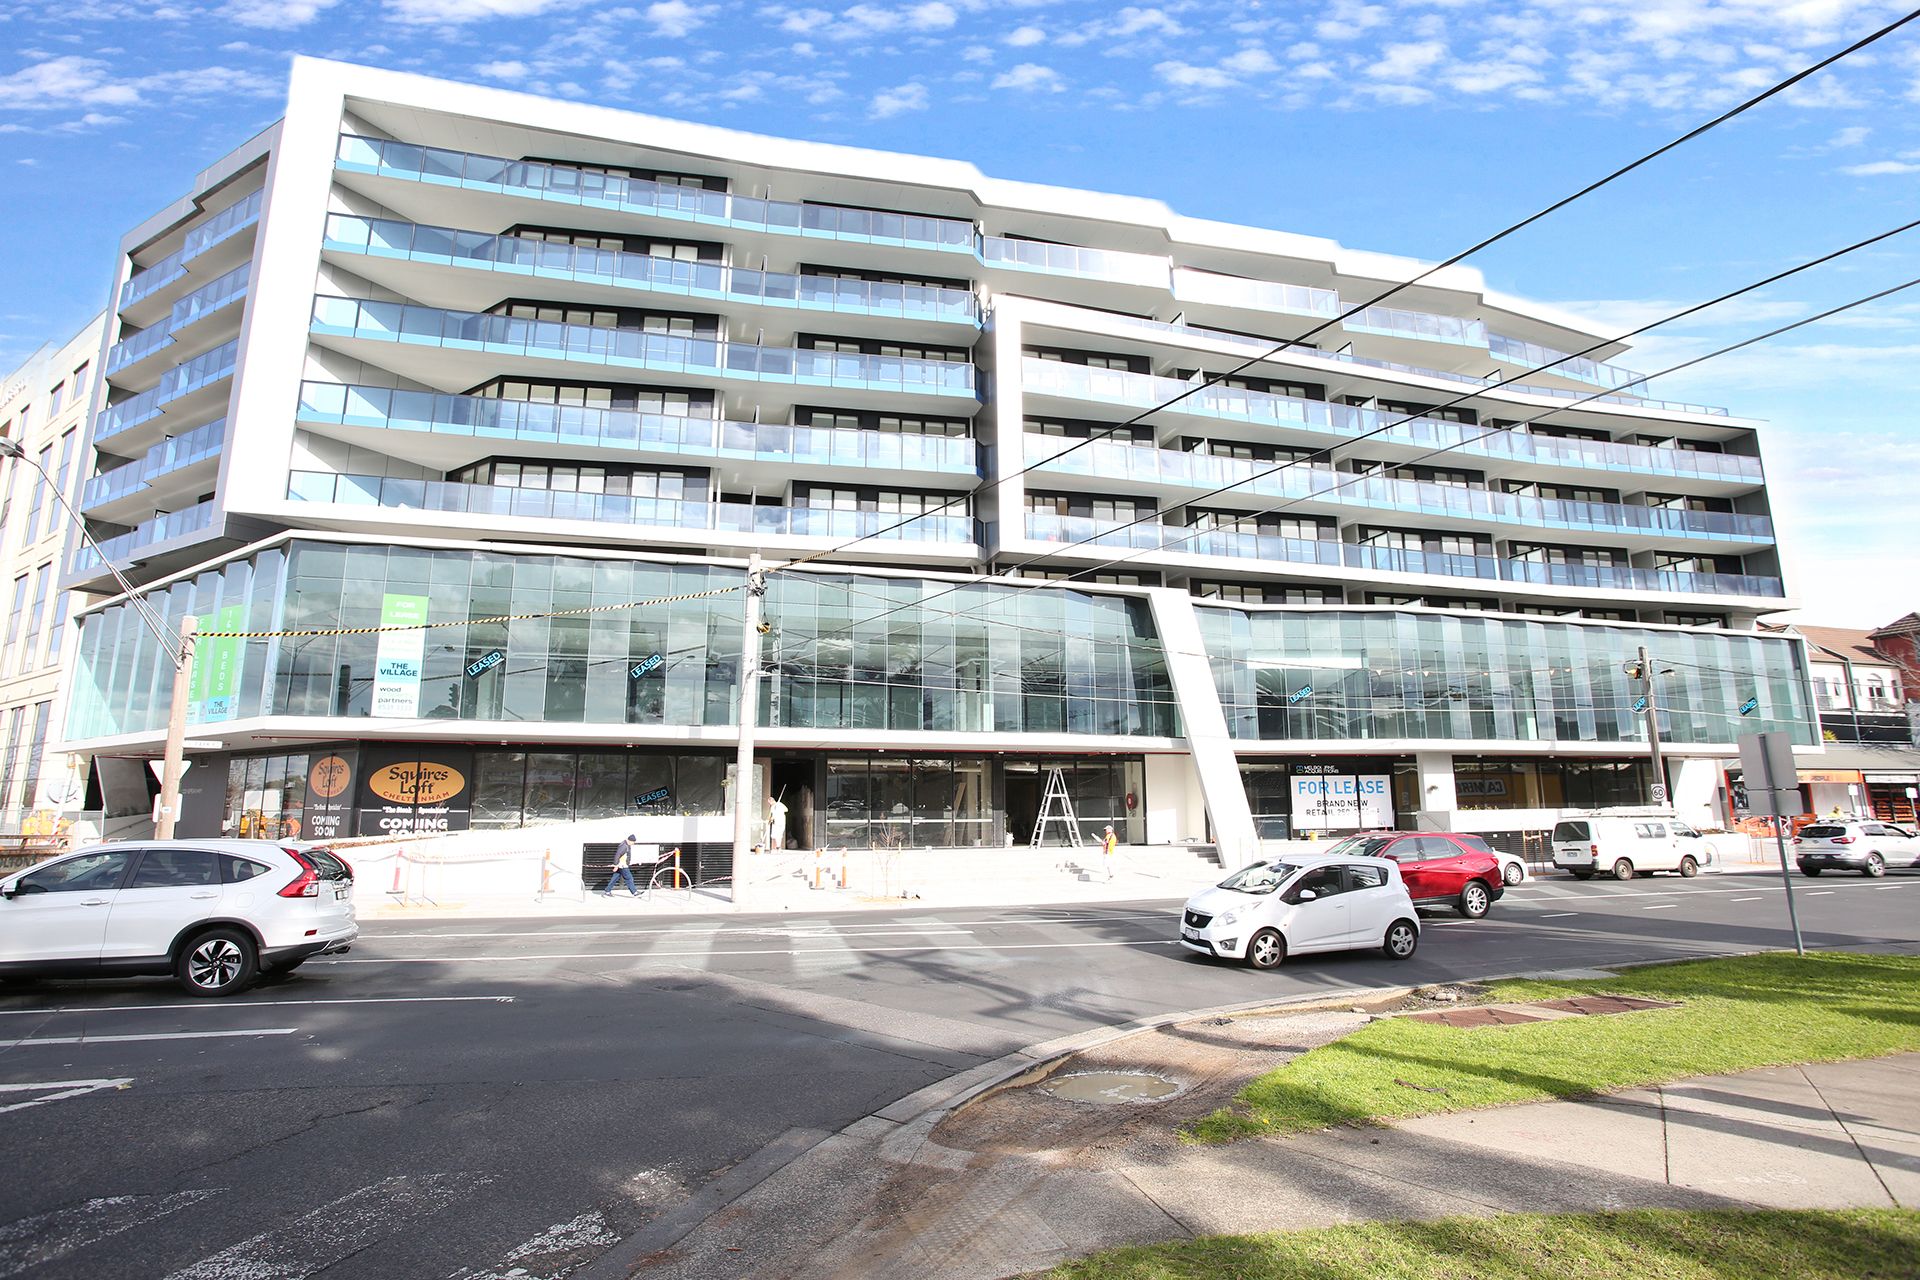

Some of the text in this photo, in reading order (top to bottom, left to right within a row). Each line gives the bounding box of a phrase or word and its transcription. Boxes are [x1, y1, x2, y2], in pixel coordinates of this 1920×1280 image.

[390, 662, 409, 670] THE
[467, 652, 501, 676] LEASED
[631, 654, 661, 678] LEASED
[379, 669, 418, 677] VILLAGE
[208, 706, 228, 715] VILLAGE
[388, 767, 449, 784] Squires
[399, 780, 435, 794] Loft
[1298, 780, 1385, 794] FOR LEASE
[637, 789, 668, 805] LEASED
[379, 818, 448, 829] COMING
[314, 826, 335, 837] SOON
